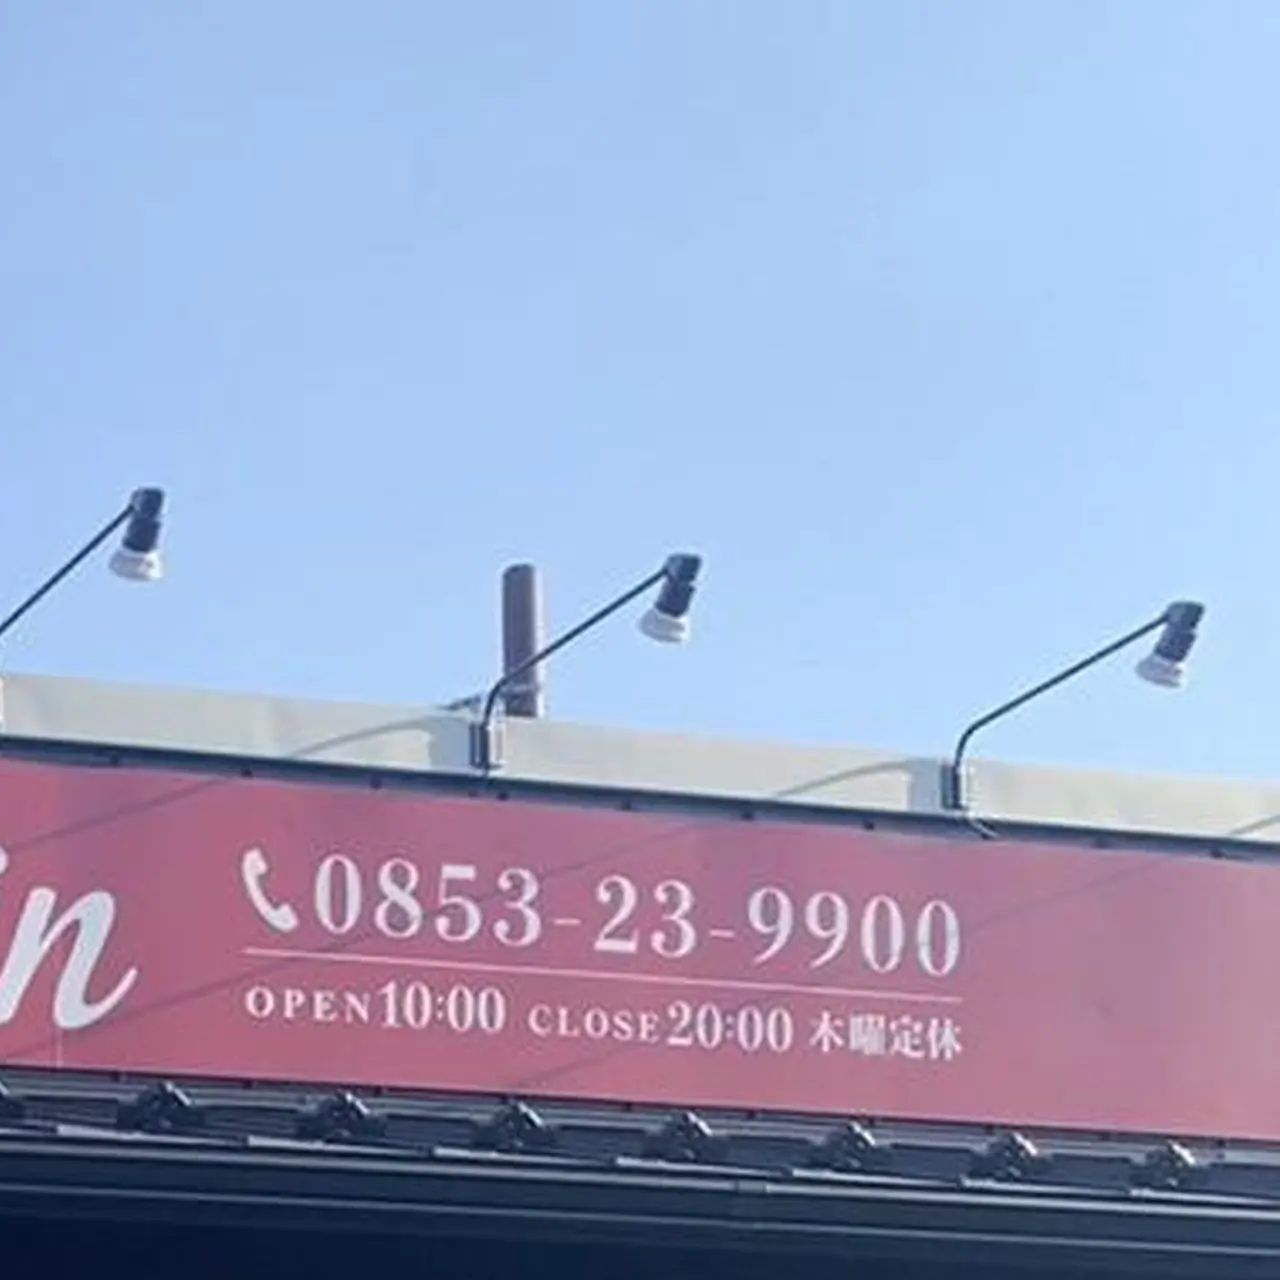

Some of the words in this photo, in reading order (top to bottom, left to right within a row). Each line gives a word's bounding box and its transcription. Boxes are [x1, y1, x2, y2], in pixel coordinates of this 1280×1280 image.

[314, 854, 962, 976] 0853-23-9900
[807, 1016, 965, 1062] 木曜定休
